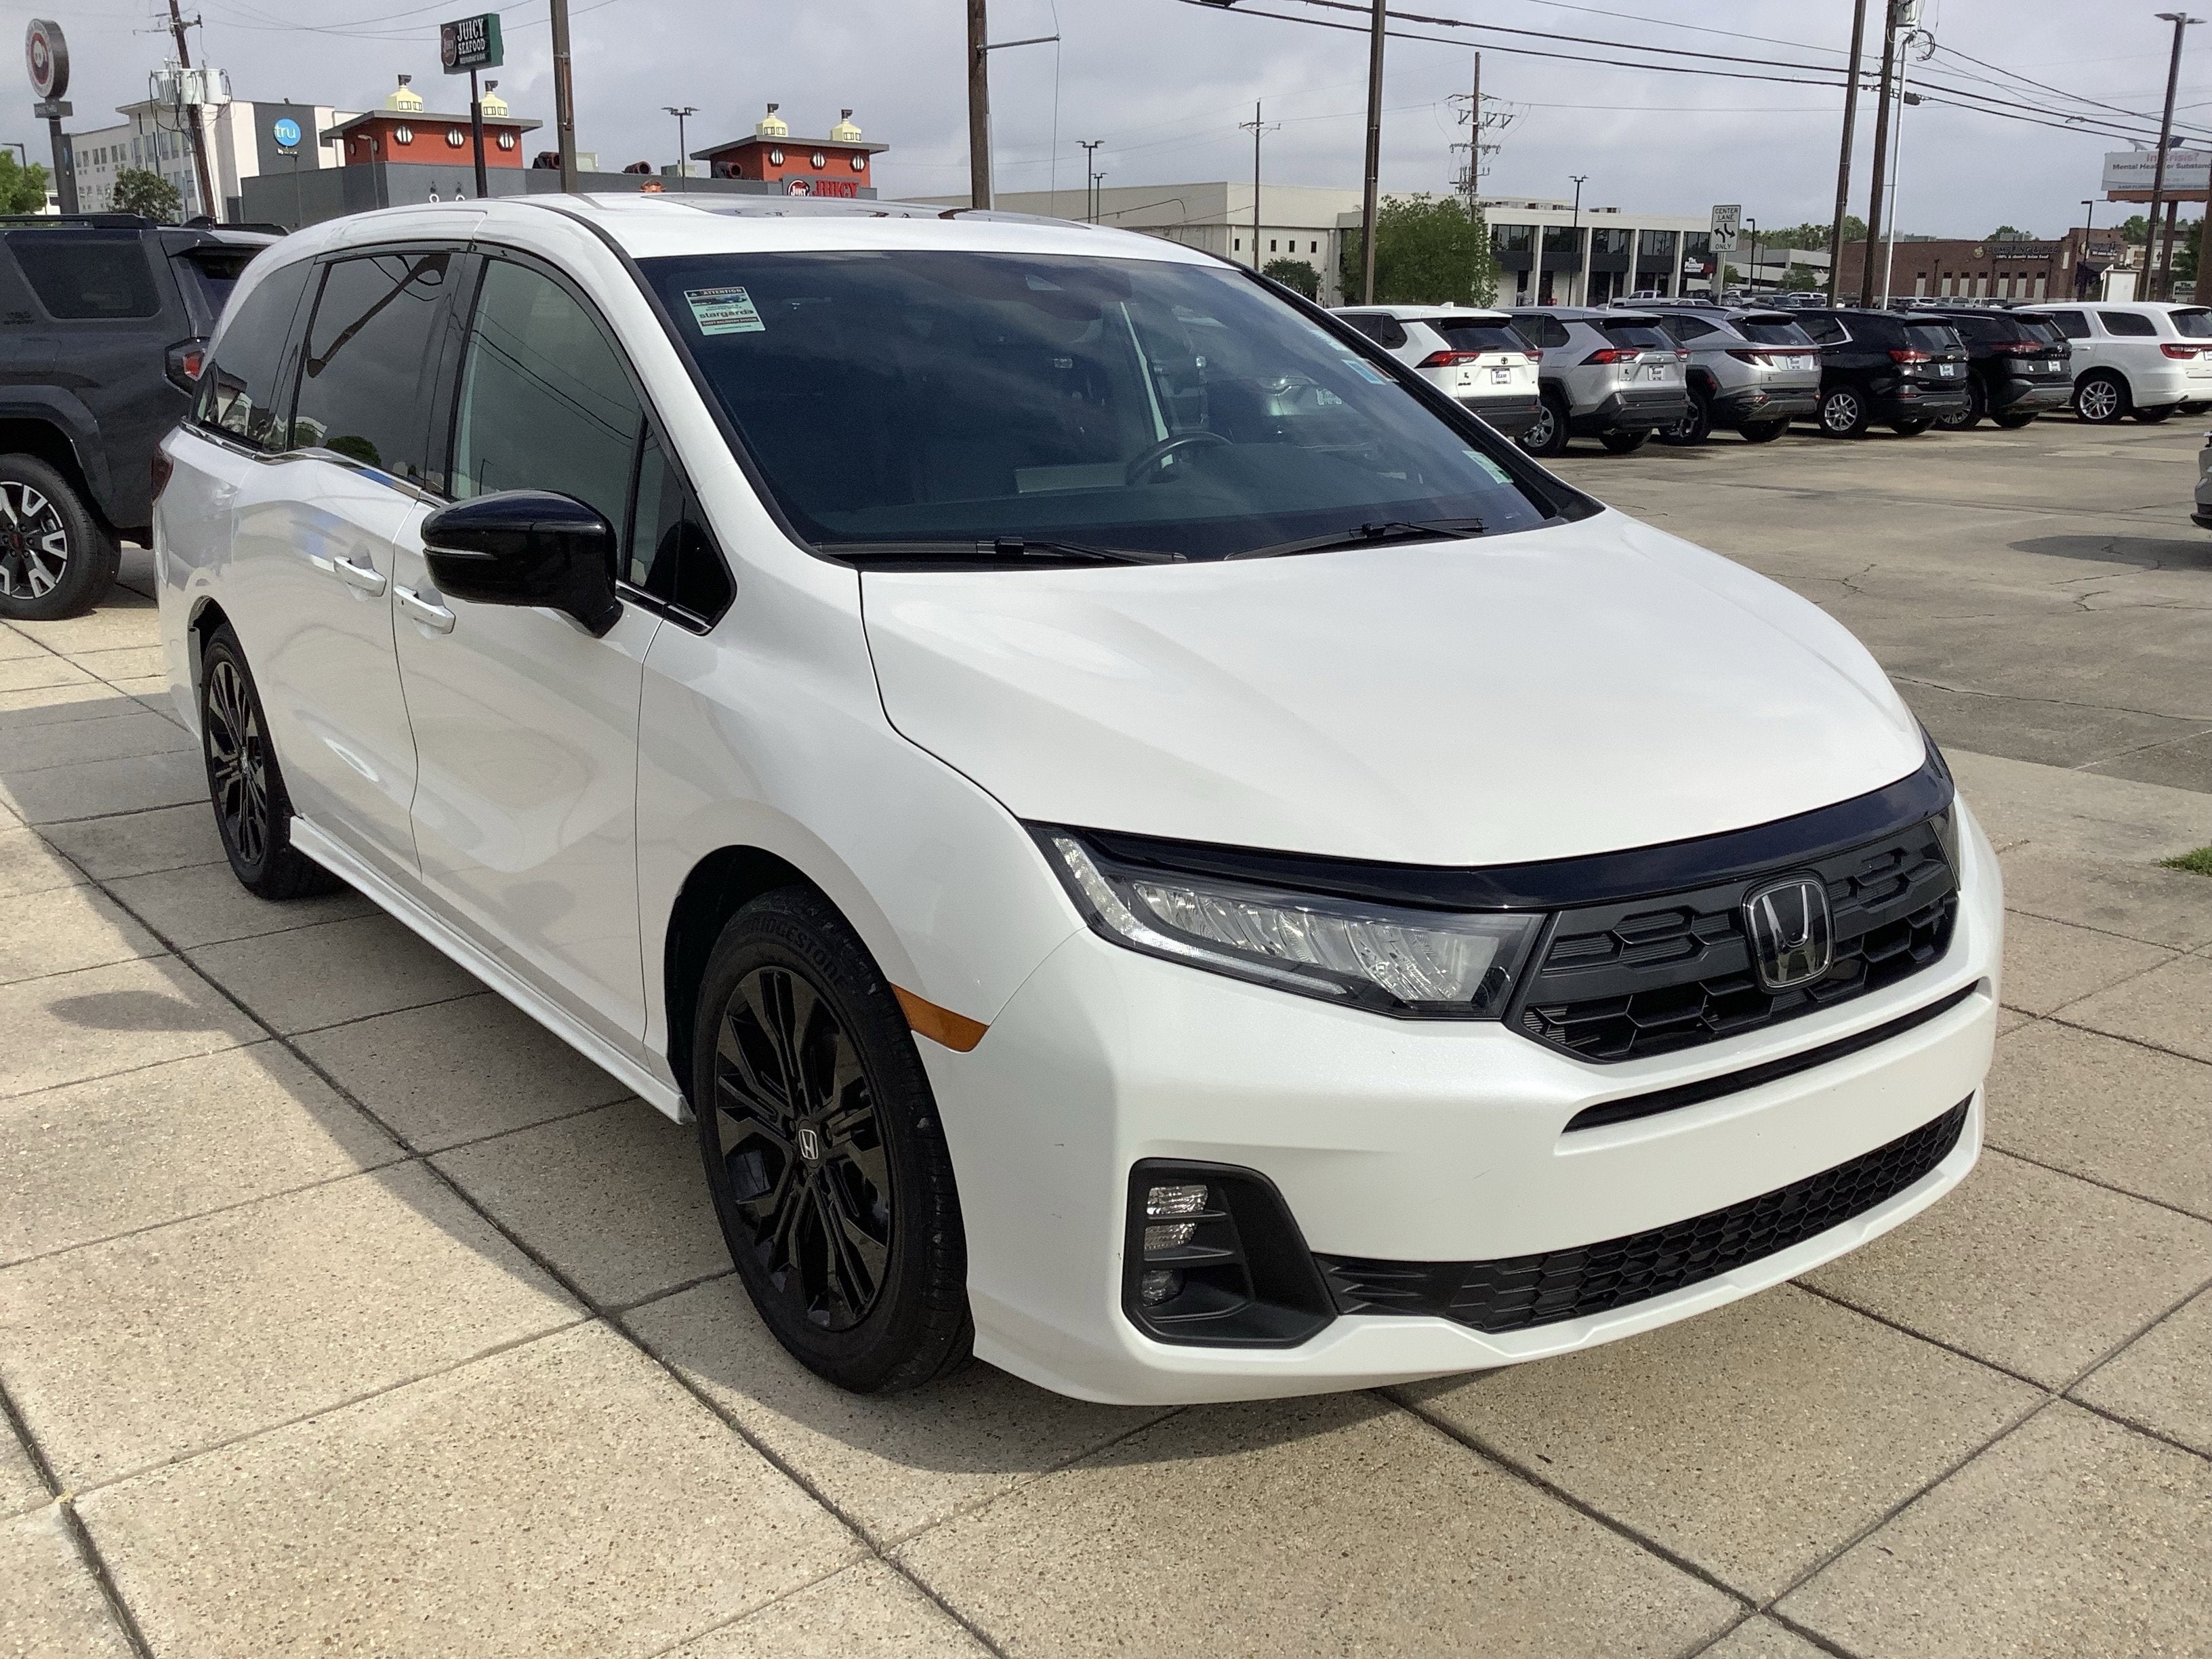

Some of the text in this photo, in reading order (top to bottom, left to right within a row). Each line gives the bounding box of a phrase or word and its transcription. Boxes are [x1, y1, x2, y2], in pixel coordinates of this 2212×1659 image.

[457, 18, 483, 41] JUICY
[458, 38, 485, 54] SEAFOOD
[274, 125, 296, 138] tru
[2147, 153, 2157, 162] In
